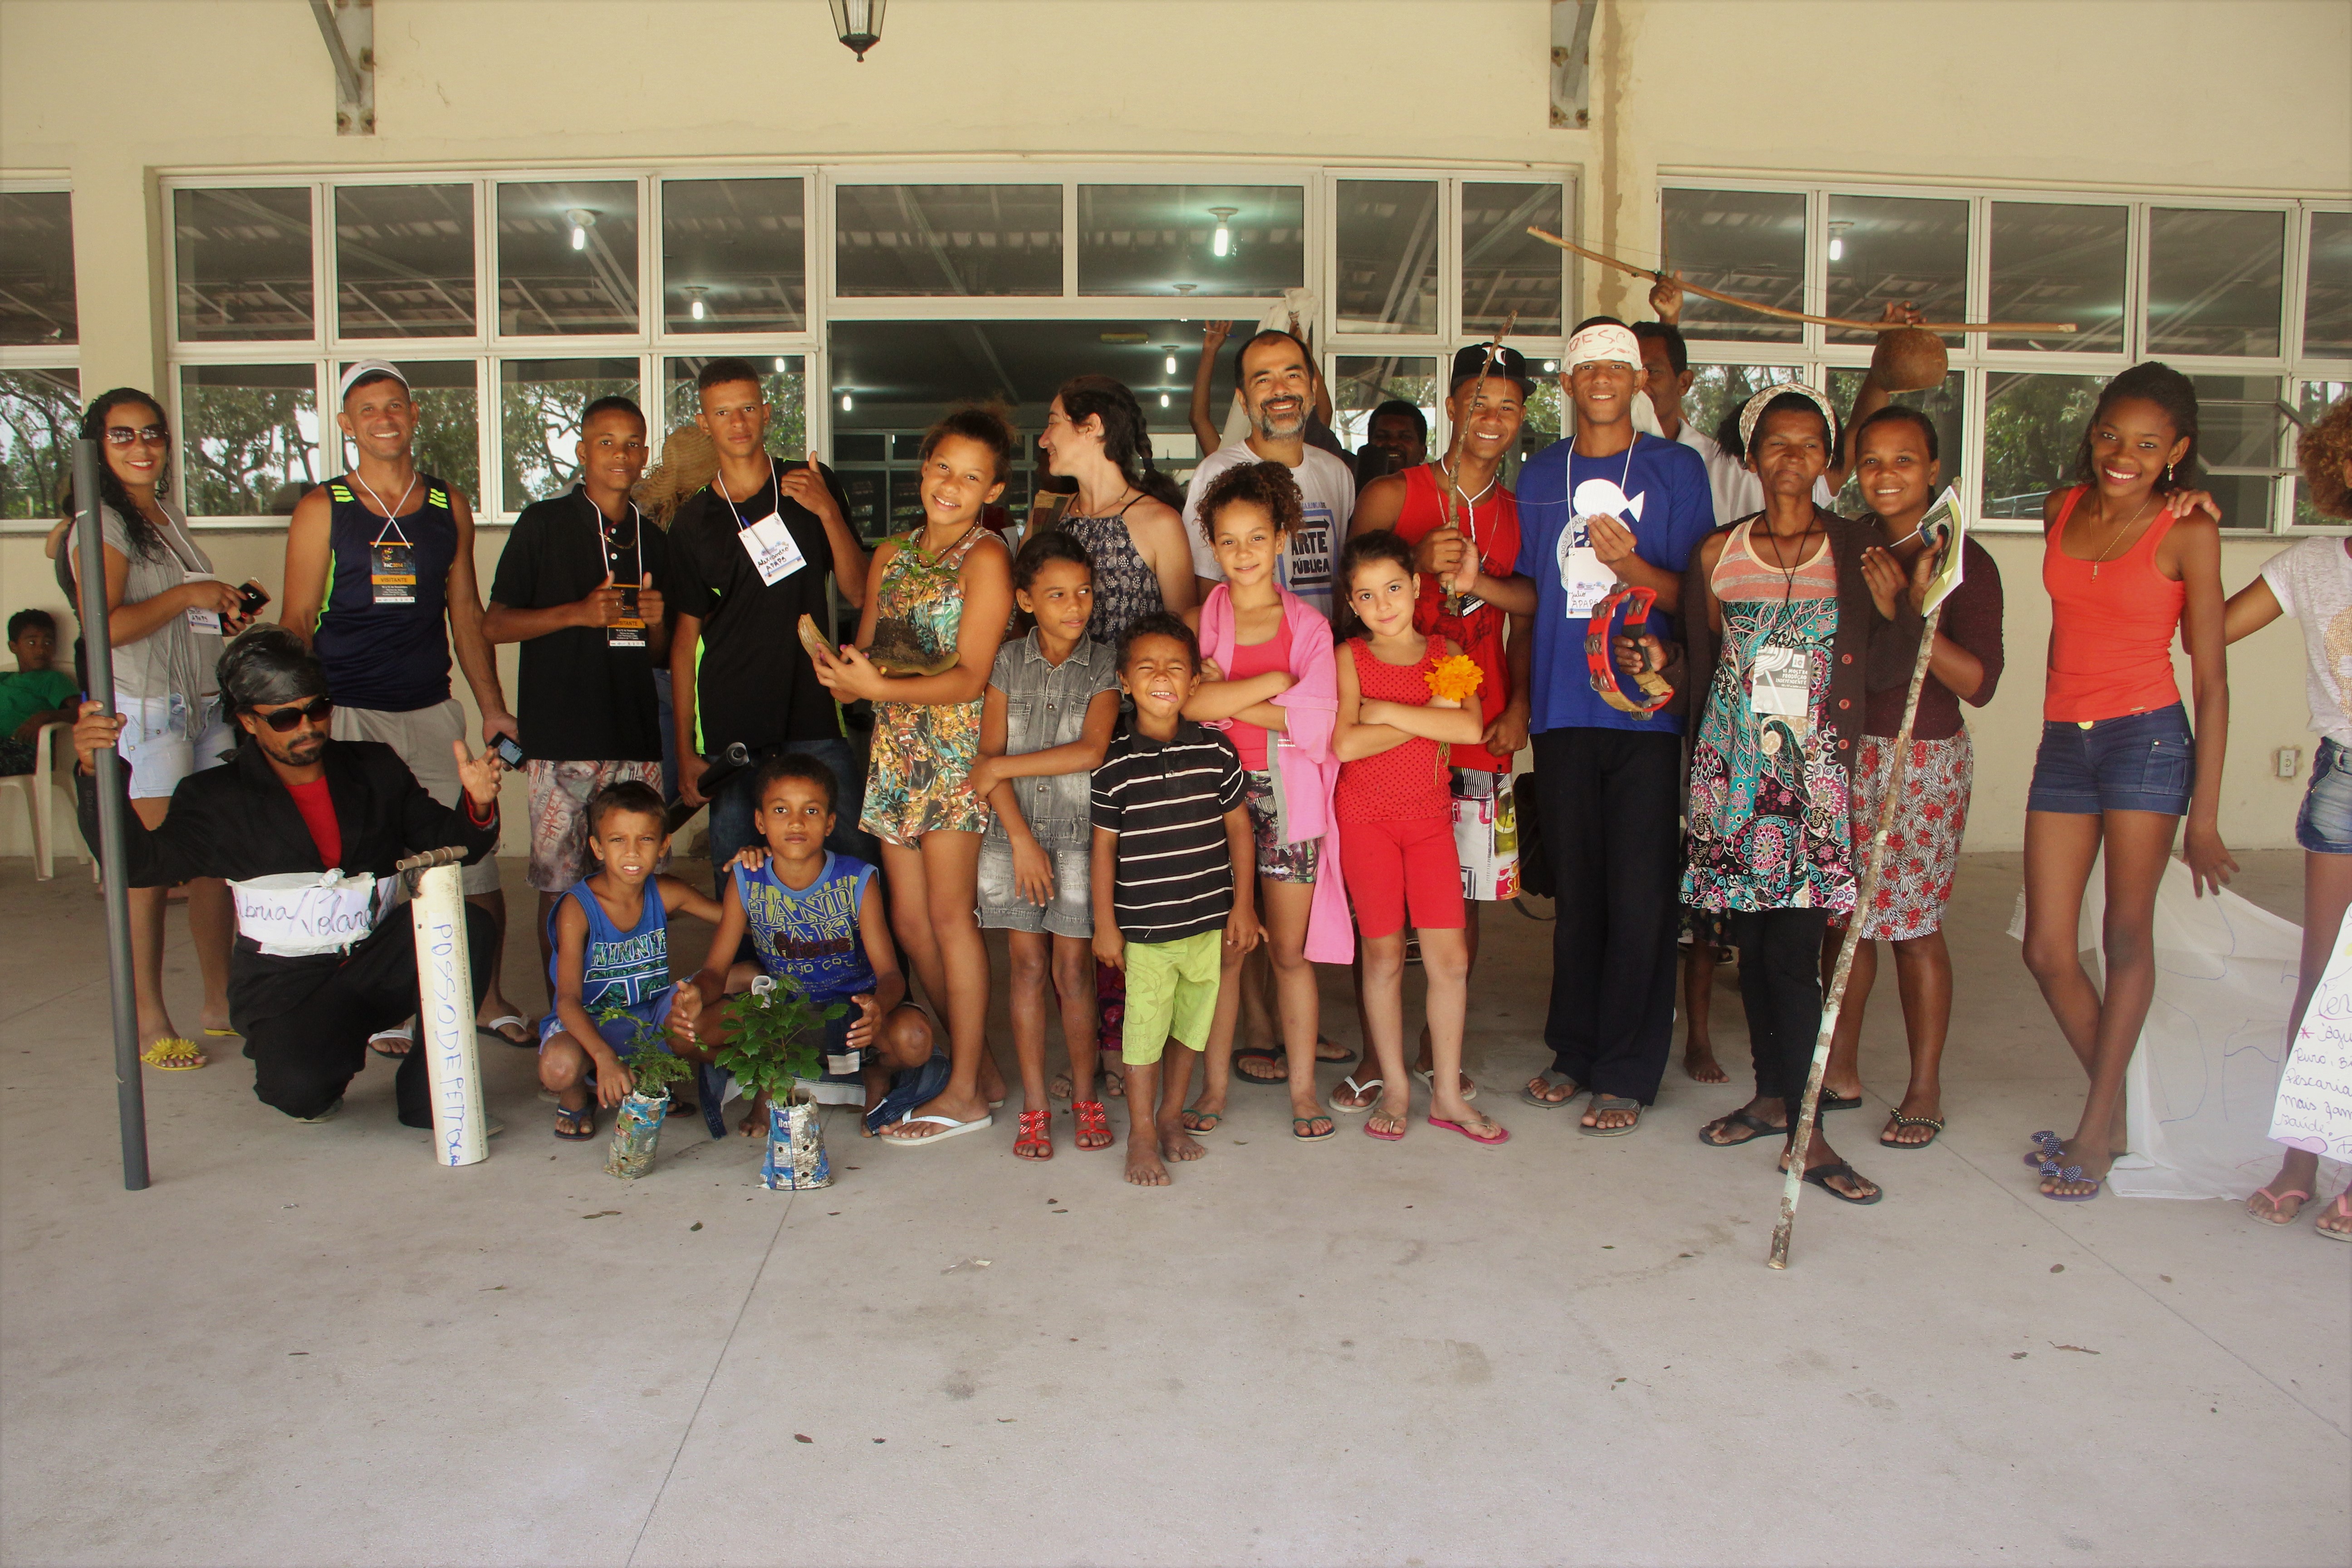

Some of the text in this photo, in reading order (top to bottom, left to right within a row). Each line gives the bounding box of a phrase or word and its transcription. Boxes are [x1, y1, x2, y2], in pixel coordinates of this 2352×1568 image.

[1292, 531, 1328, 555] ARTE
[1293, 558, 1330, 575] PÚBLICA
[787, 962, 813, 975] AND
